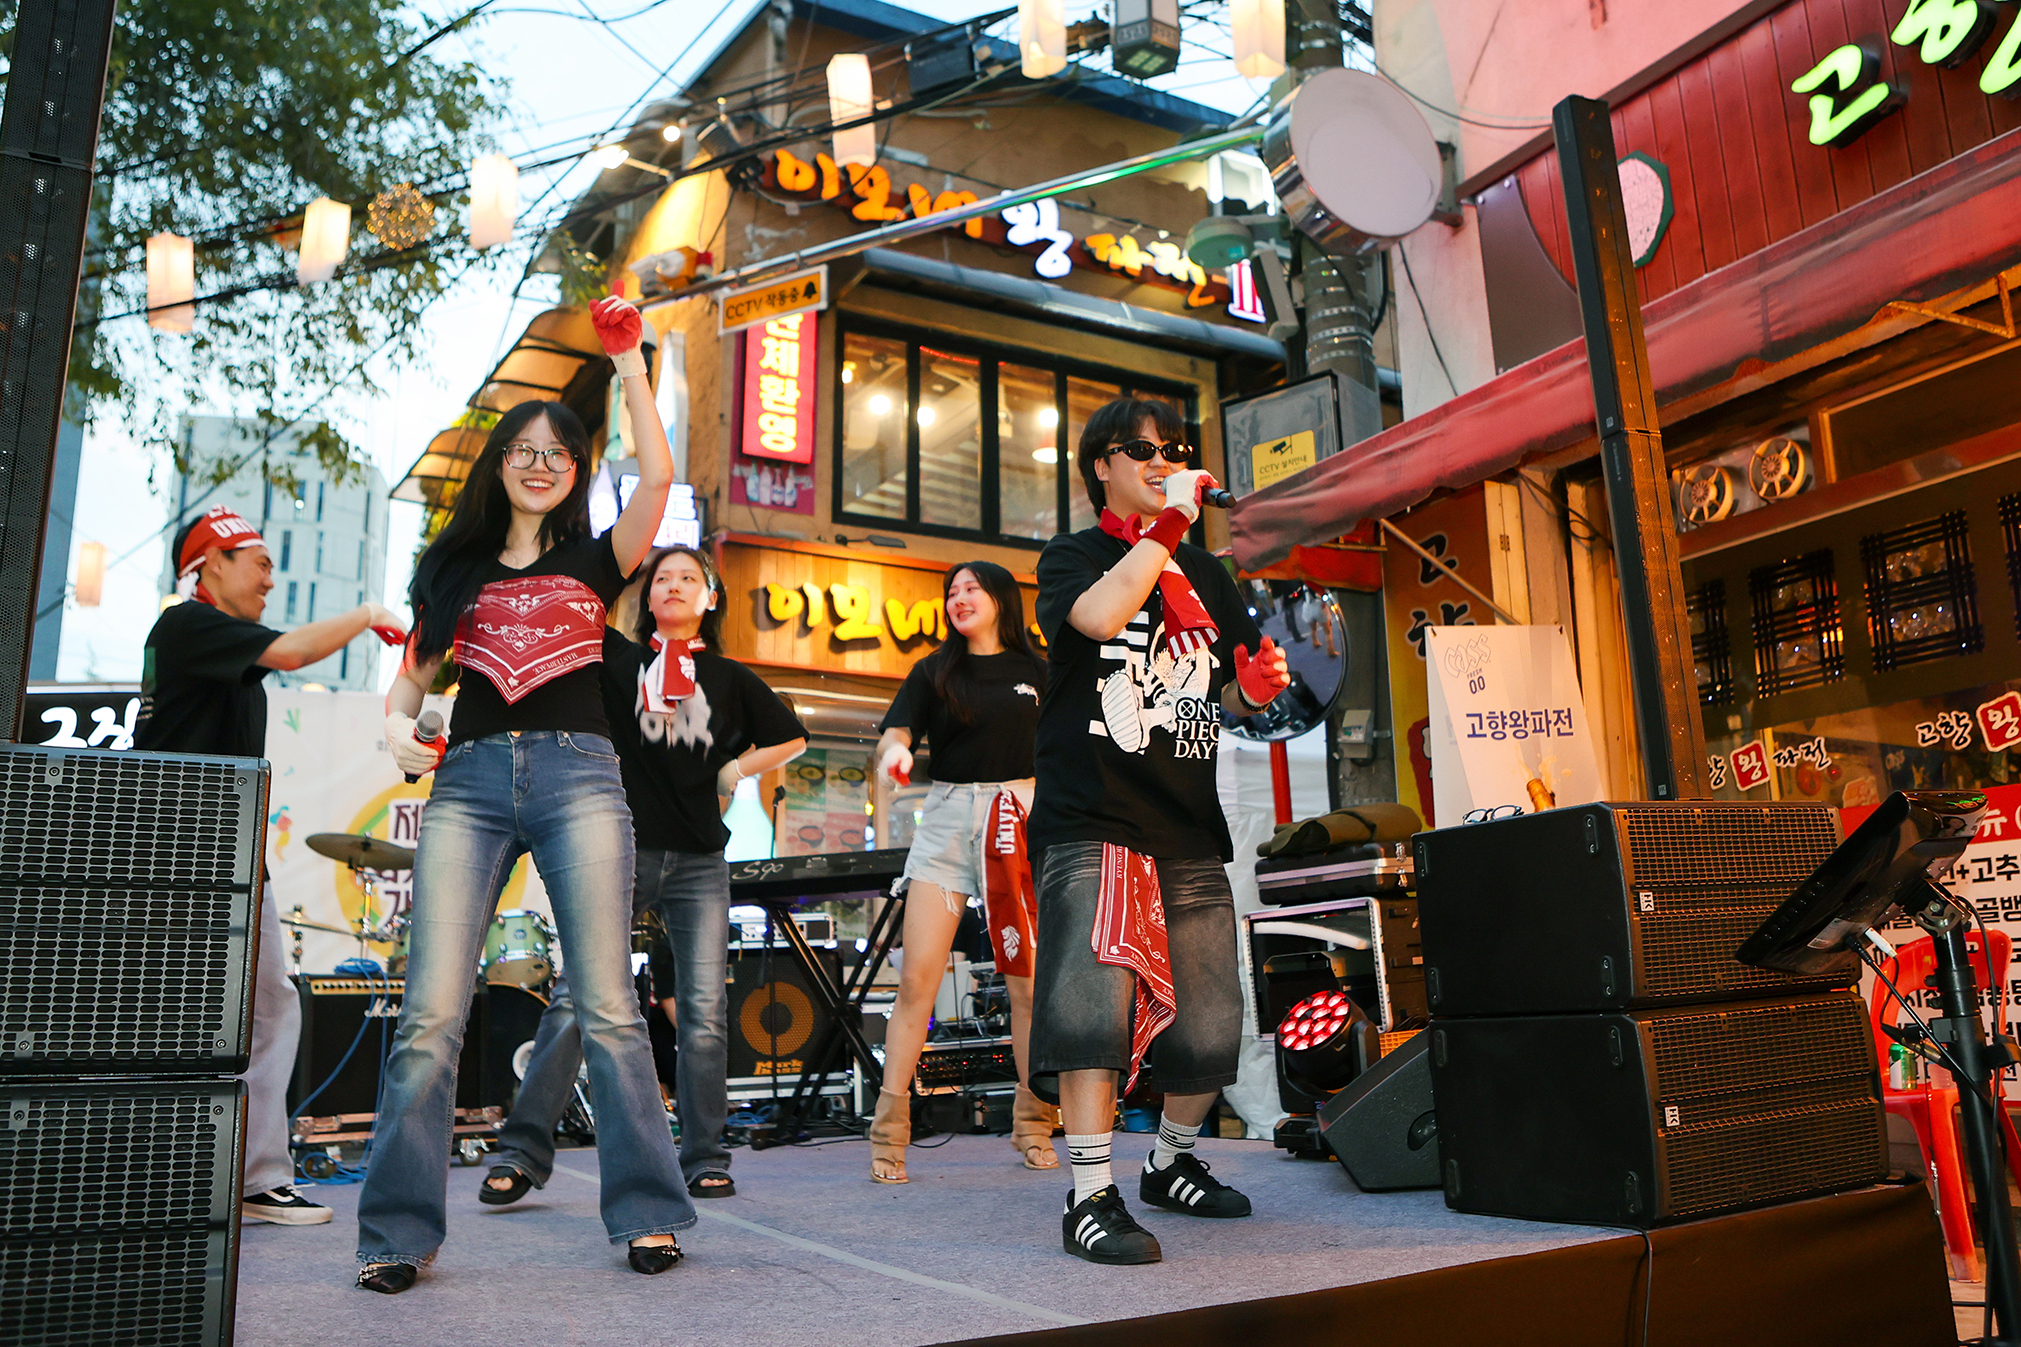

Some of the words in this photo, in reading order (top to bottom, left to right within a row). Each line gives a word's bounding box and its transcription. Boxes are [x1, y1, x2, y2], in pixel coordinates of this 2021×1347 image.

[725, 297, 762, 319] CCTV
[766, 287, 799, 307] 작동중
[1259, 463, 1280, 475] CCTV
[1176, 698, 1220, 720] ONE
[1175, 719, 1220, 741] PIEC
[1465, 707, 1574, 741] 고향왕파전
[1916, 711, 1972, 751] 고향
